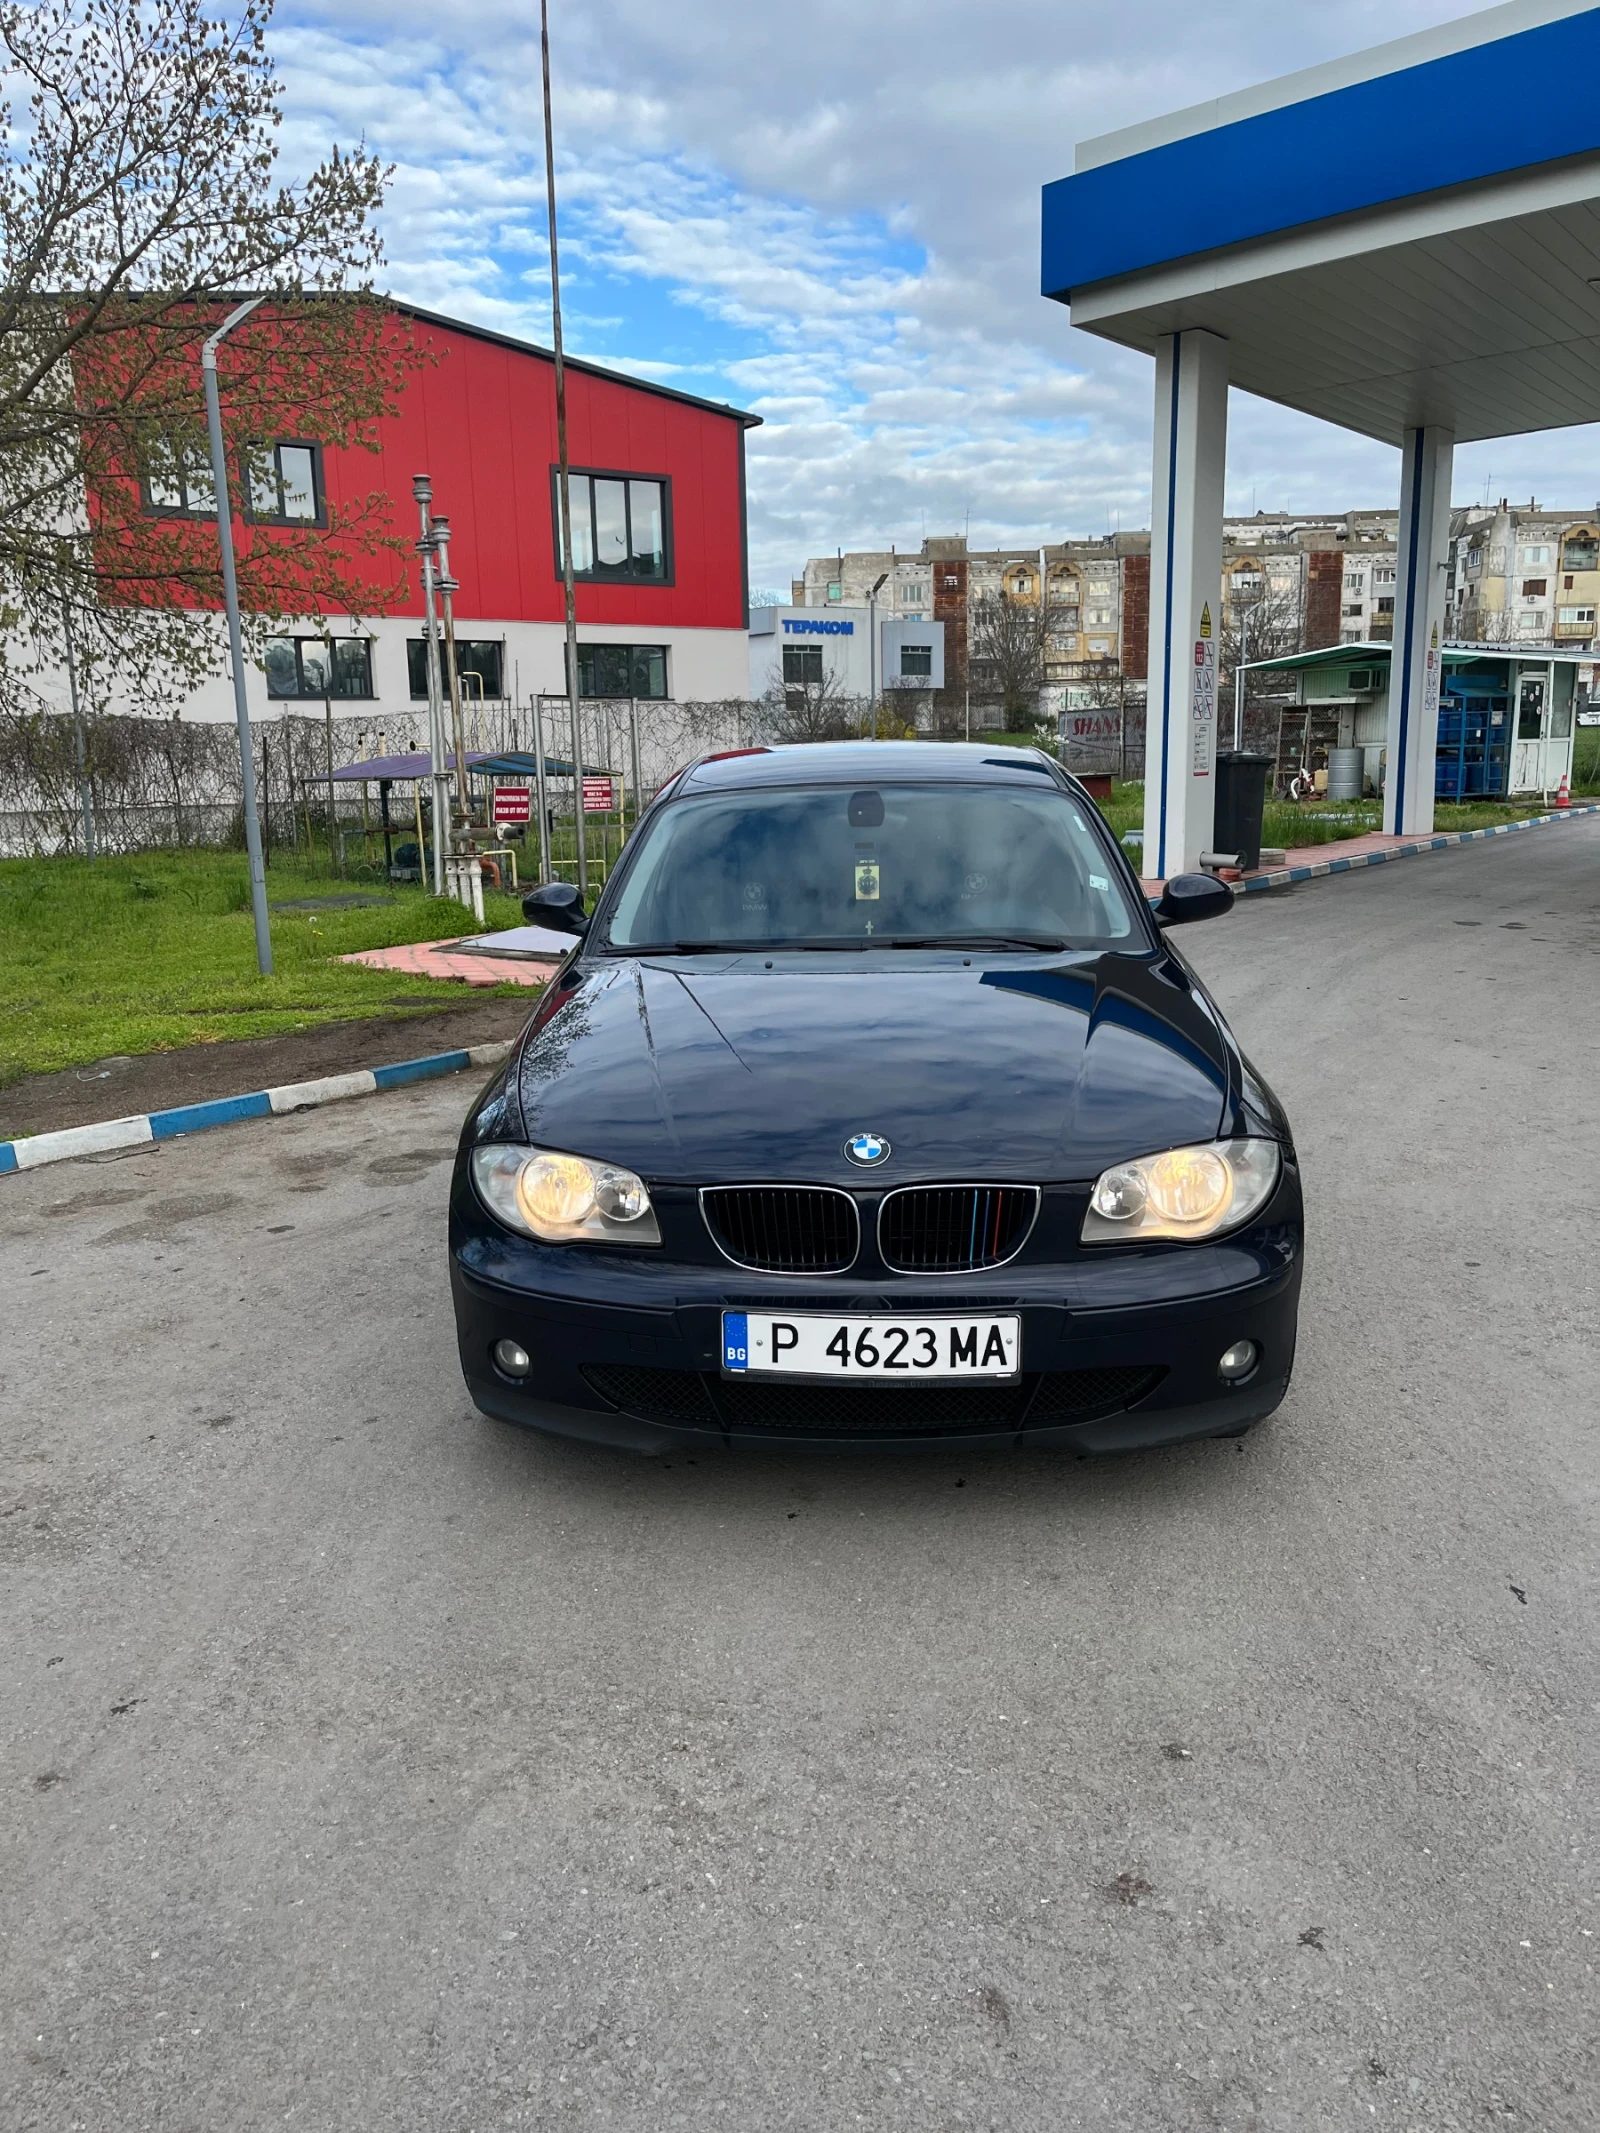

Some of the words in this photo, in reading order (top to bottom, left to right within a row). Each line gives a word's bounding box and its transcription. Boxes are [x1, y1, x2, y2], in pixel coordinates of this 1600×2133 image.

[782, 619, 854, 635] ТЕРАКОМ
[1195, 653, 1204, 663] 112
[742, 903, 767, 911] BMW
[771, 1322, 799, 1364] P
[825, 1326, 938, 1369] 4623
[950, 1324, 1008, 1368] MA
[727, 1347, 746, 1361] BG
